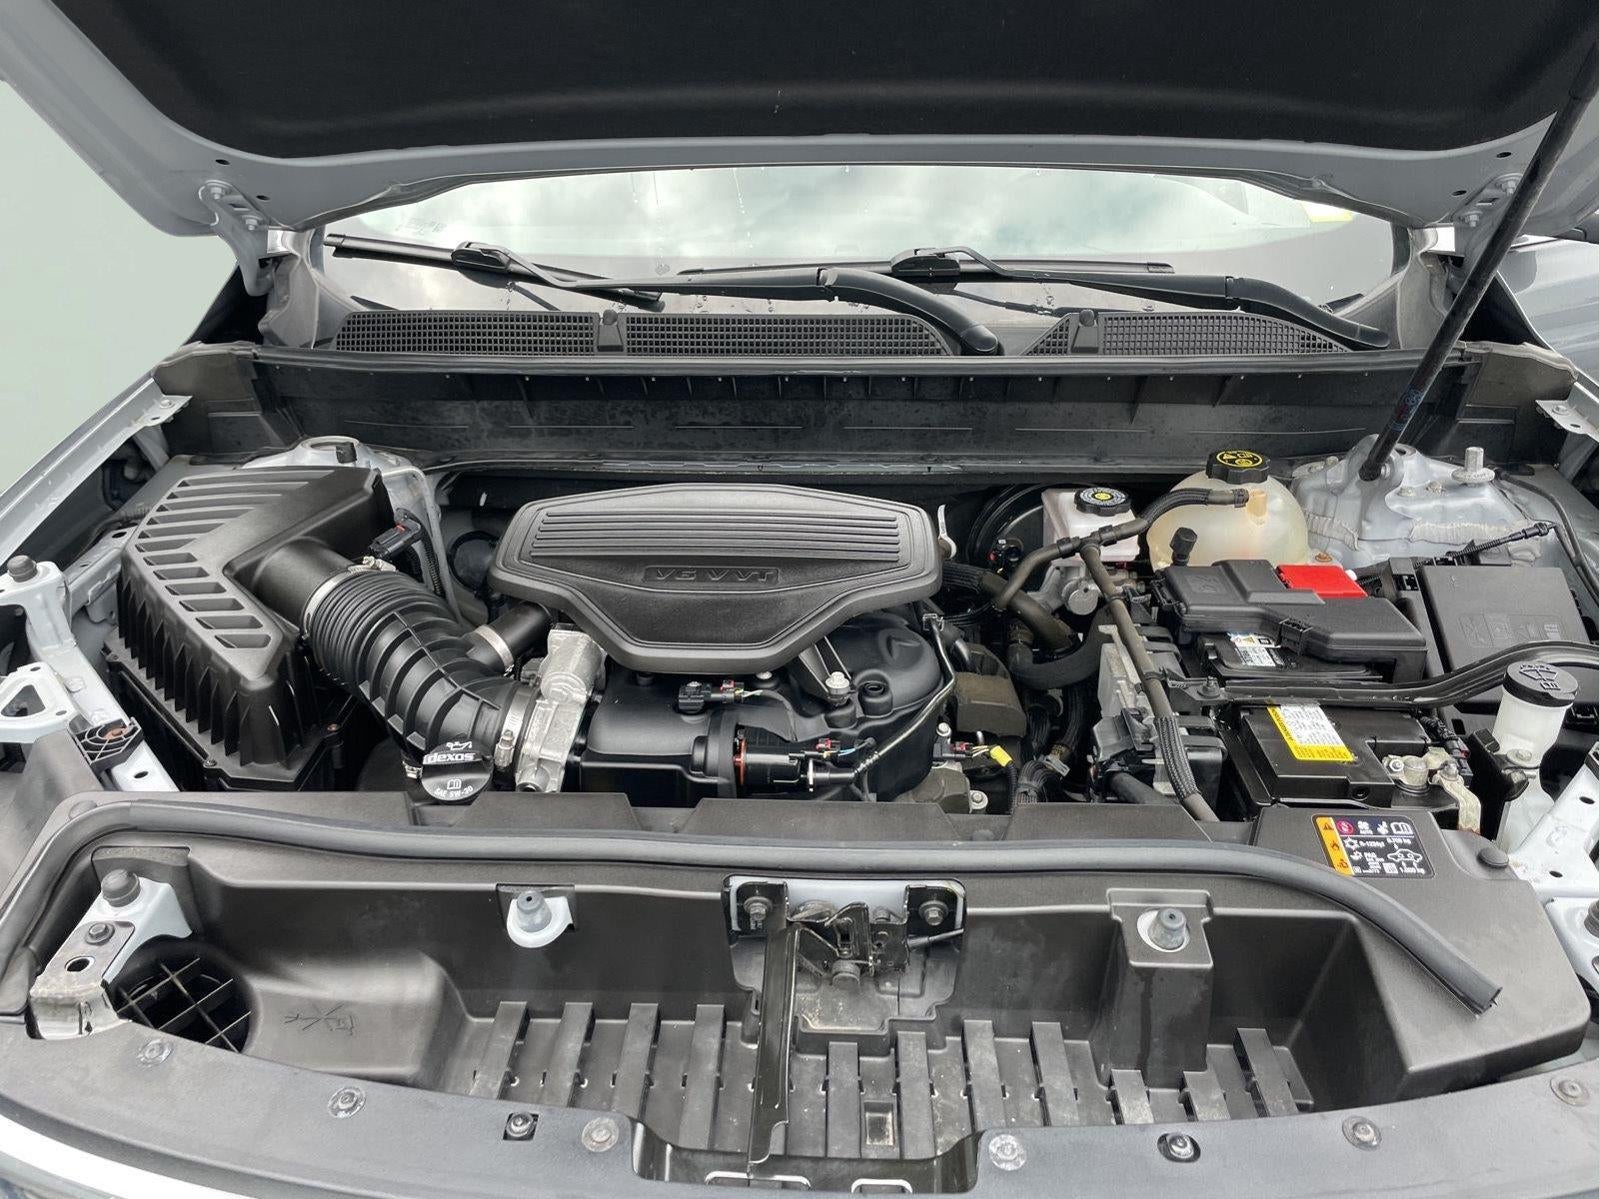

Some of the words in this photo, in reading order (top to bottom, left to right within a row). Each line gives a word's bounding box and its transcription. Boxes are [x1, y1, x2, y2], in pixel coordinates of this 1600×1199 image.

[656, 569, 697, 581] V6
[707, 569, 774, 582] VVT
[425, 752, 476, 763] dexos
[434, 787, 447, 798] SAE
